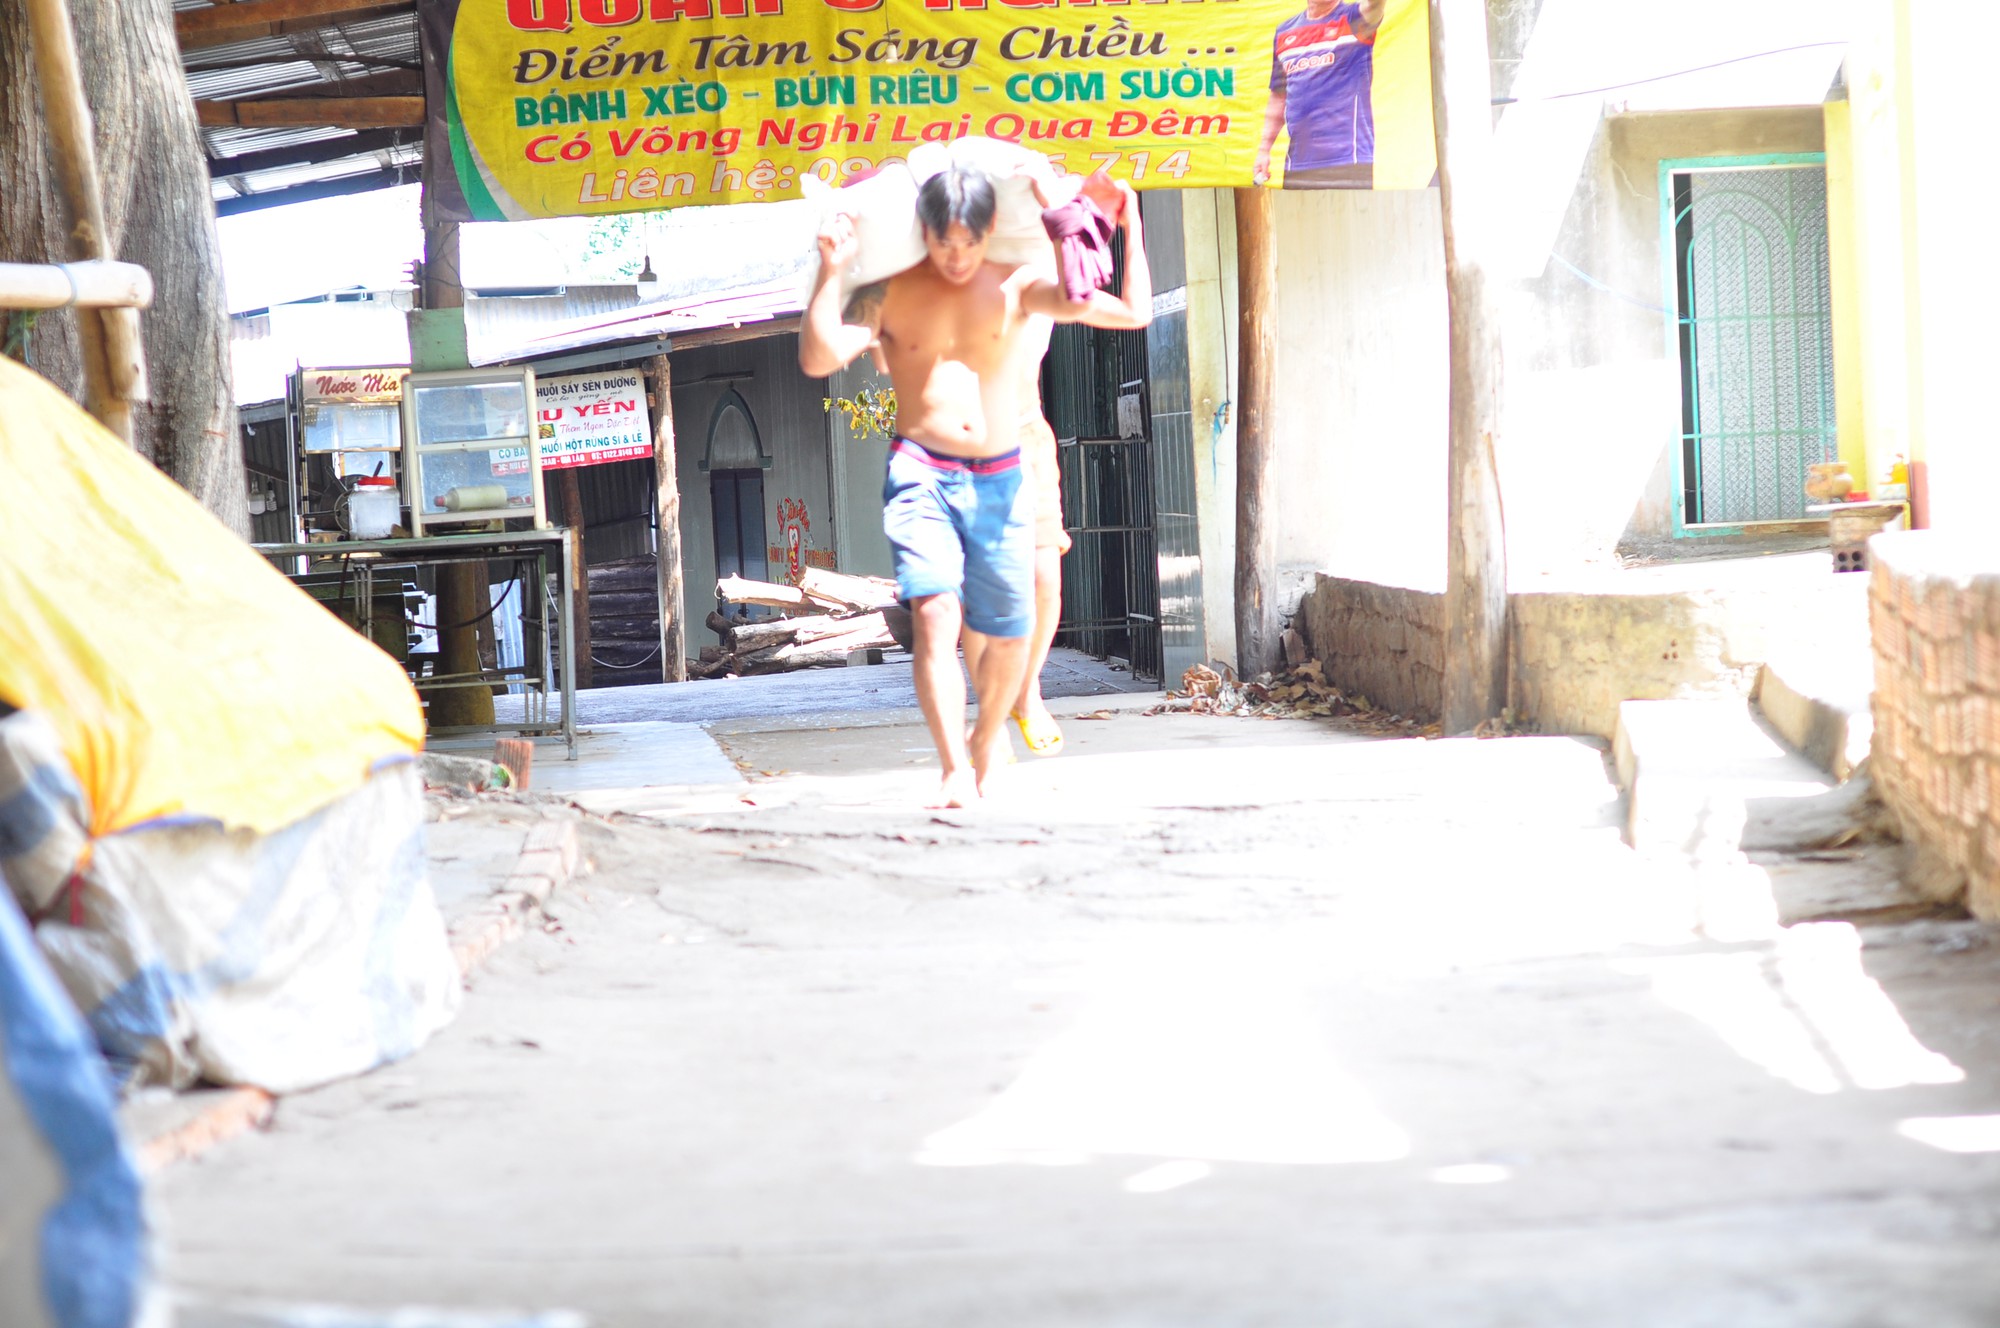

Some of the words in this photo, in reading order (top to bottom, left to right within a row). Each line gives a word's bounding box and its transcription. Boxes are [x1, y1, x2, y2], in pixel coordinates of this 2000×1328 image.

[512, 35, 668, 84] Điểm
[689, 33, 810, 72] Tâm
[828, 27, 978, 69] Sáng
[1000, 15, 1167, 62] Chiều
[514, 87, 627, 127] BÁNH
[641, 76, 728, 116] XÈO
[774, 70, 856, 108] BÚN
[869, 68, 958, 105] RIÊU
[1005, 71, 1105, 102] CƠM
[1120, 61, 1234, 100] SƯỜN
[524, 131, 592, 163] Có
[608, 125, 741, 157] Võng
[756, 112, 881, 151] Nghỉ
[984, 112, 1094, 144] Qua
[1106, 108, 1230, 137] Đêm
[577, 166, 696, 204] Liên
[709, 158, 796, 199] hệ:
[316, 375, 357, 396] Nước
[362, 373, 399, 393] Mía
[536, 382, 559, 398] HUỐI
[573, 397, 635, 417] YẾN
[539, 439, 563, 454] HUỐI
